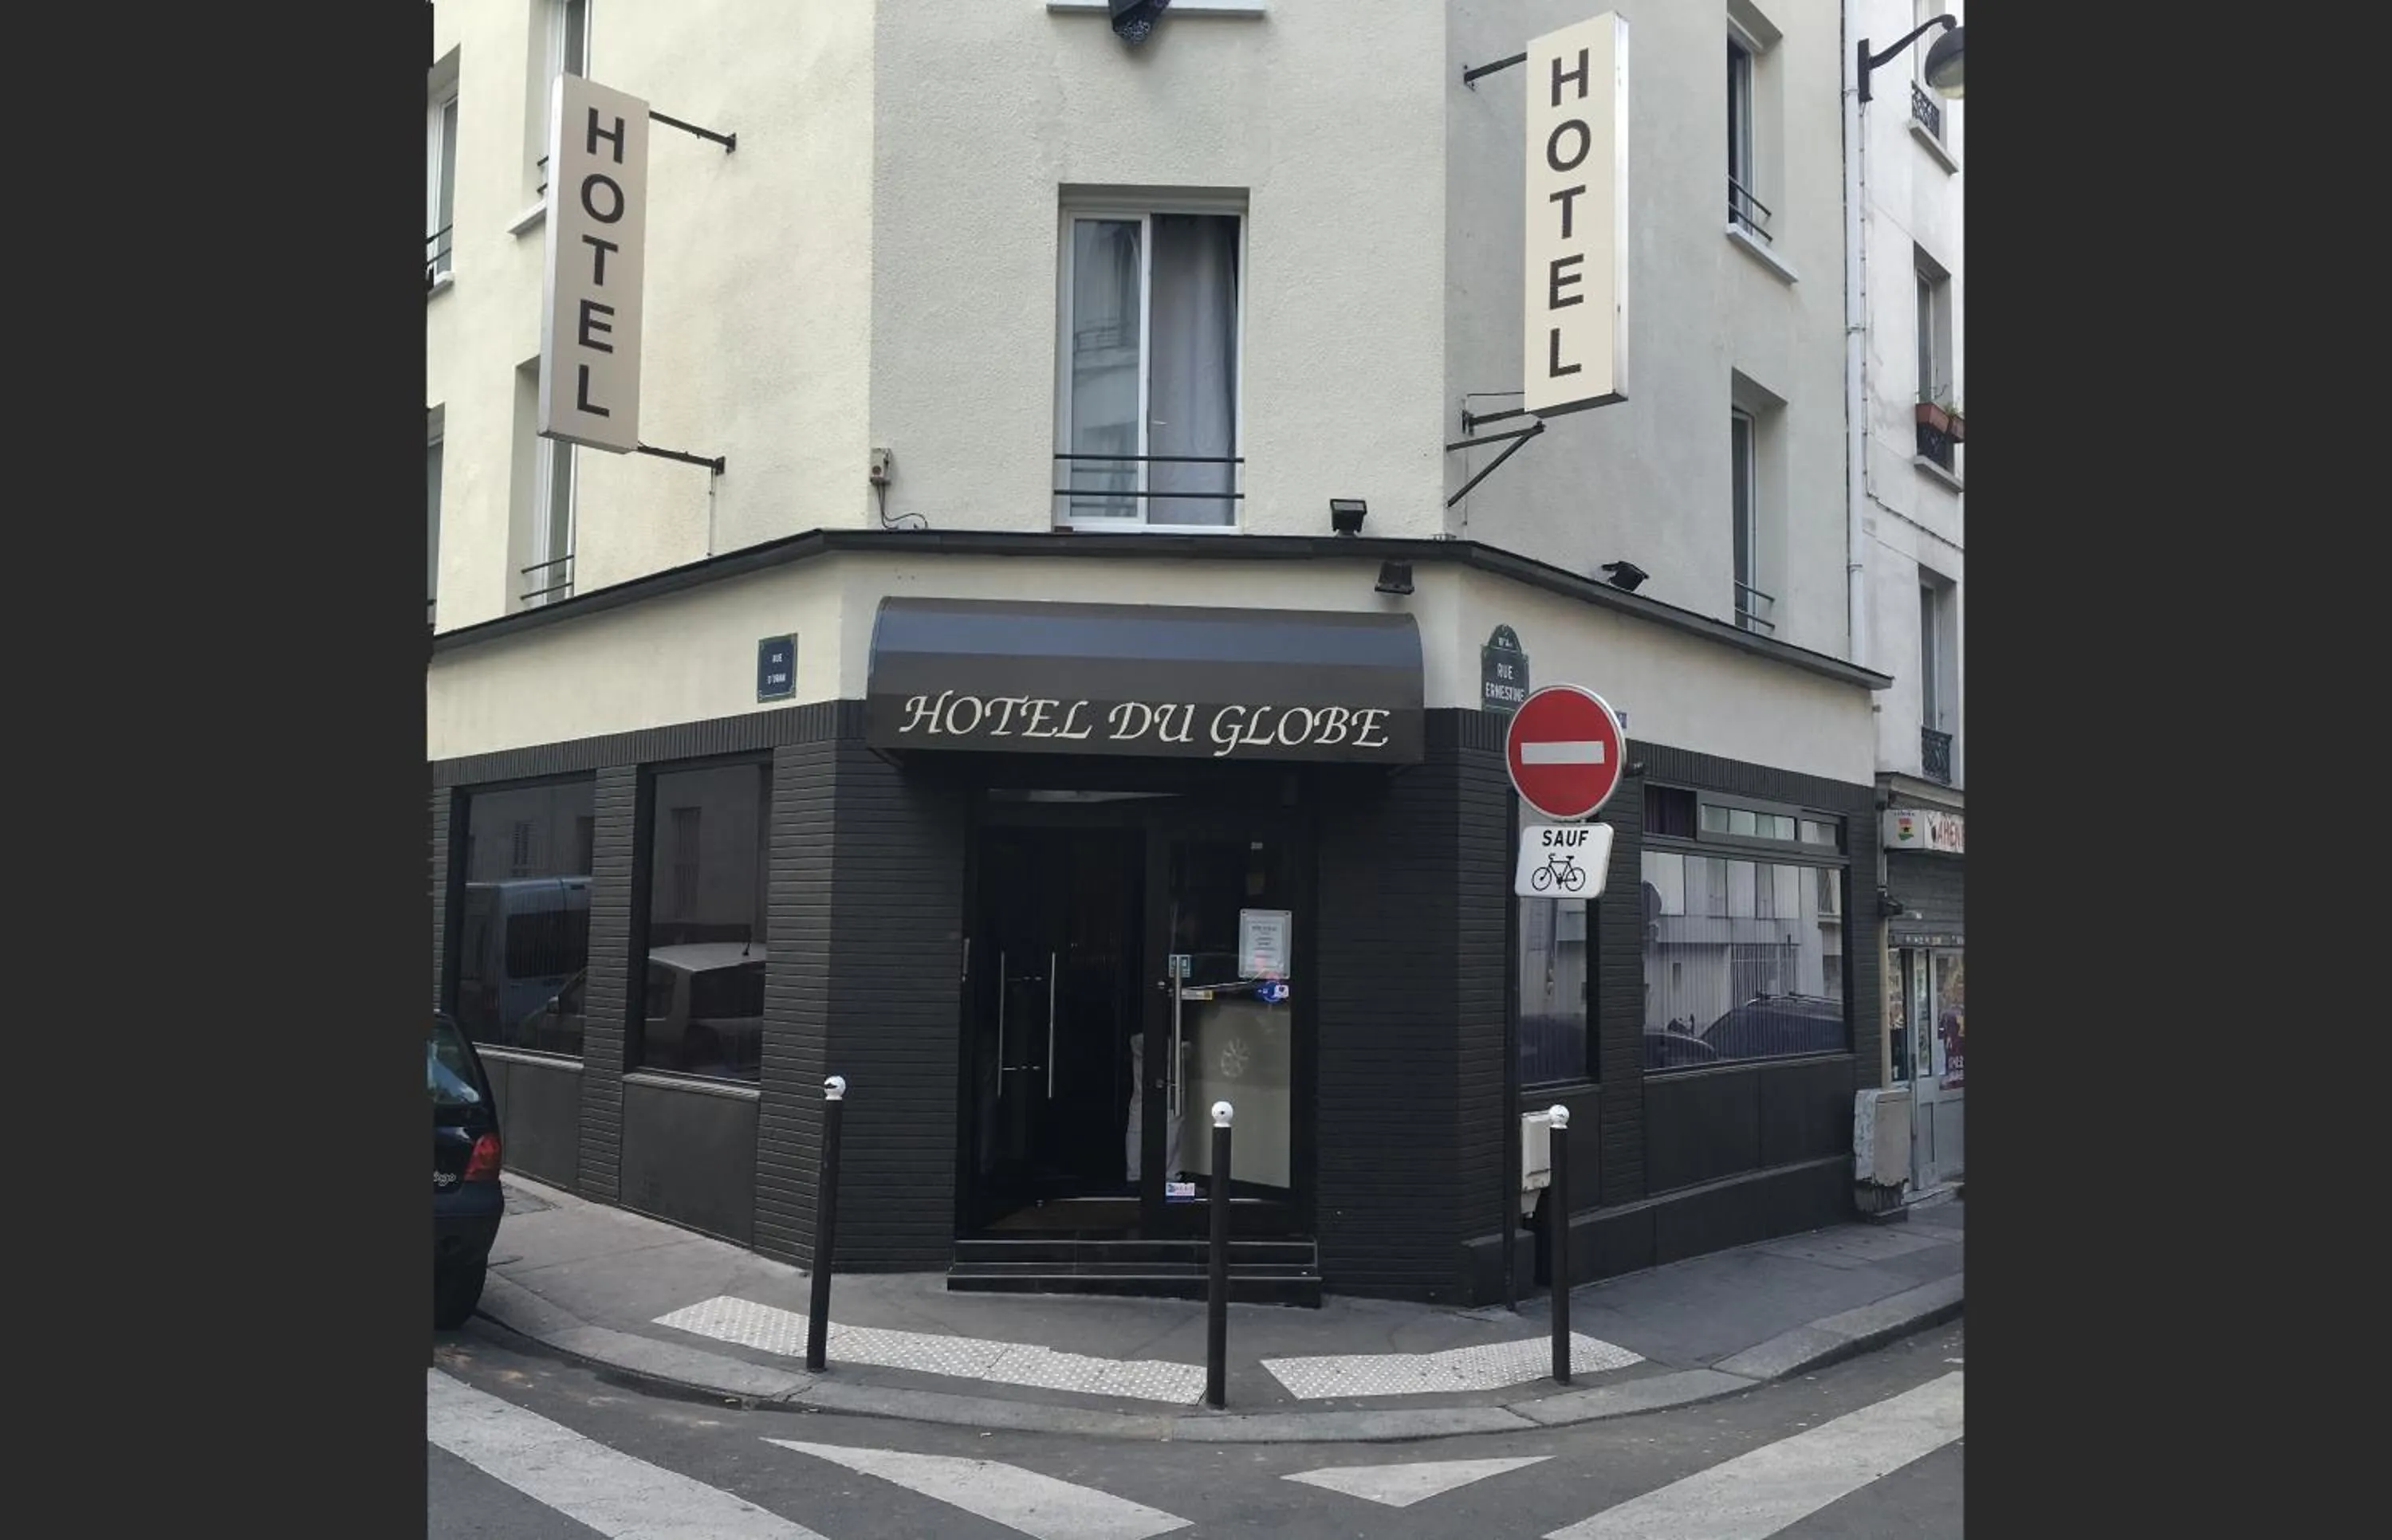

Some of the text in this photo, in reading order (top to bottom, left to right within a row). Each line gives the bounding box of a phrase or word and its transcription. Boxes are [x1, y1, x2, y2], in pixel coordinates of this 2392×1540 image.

[1547, 48, 1591, 379] HOTEL
[576, 107, 625, 418] HOTEL
[1485, 682, 1525, 702] ERNESTINE
[1497, 662, 1514, 680] RUE
[899, 689, 1391, 756] HOTEL DU GLOBE
[1542, 830, 1589, 847] SAUF
